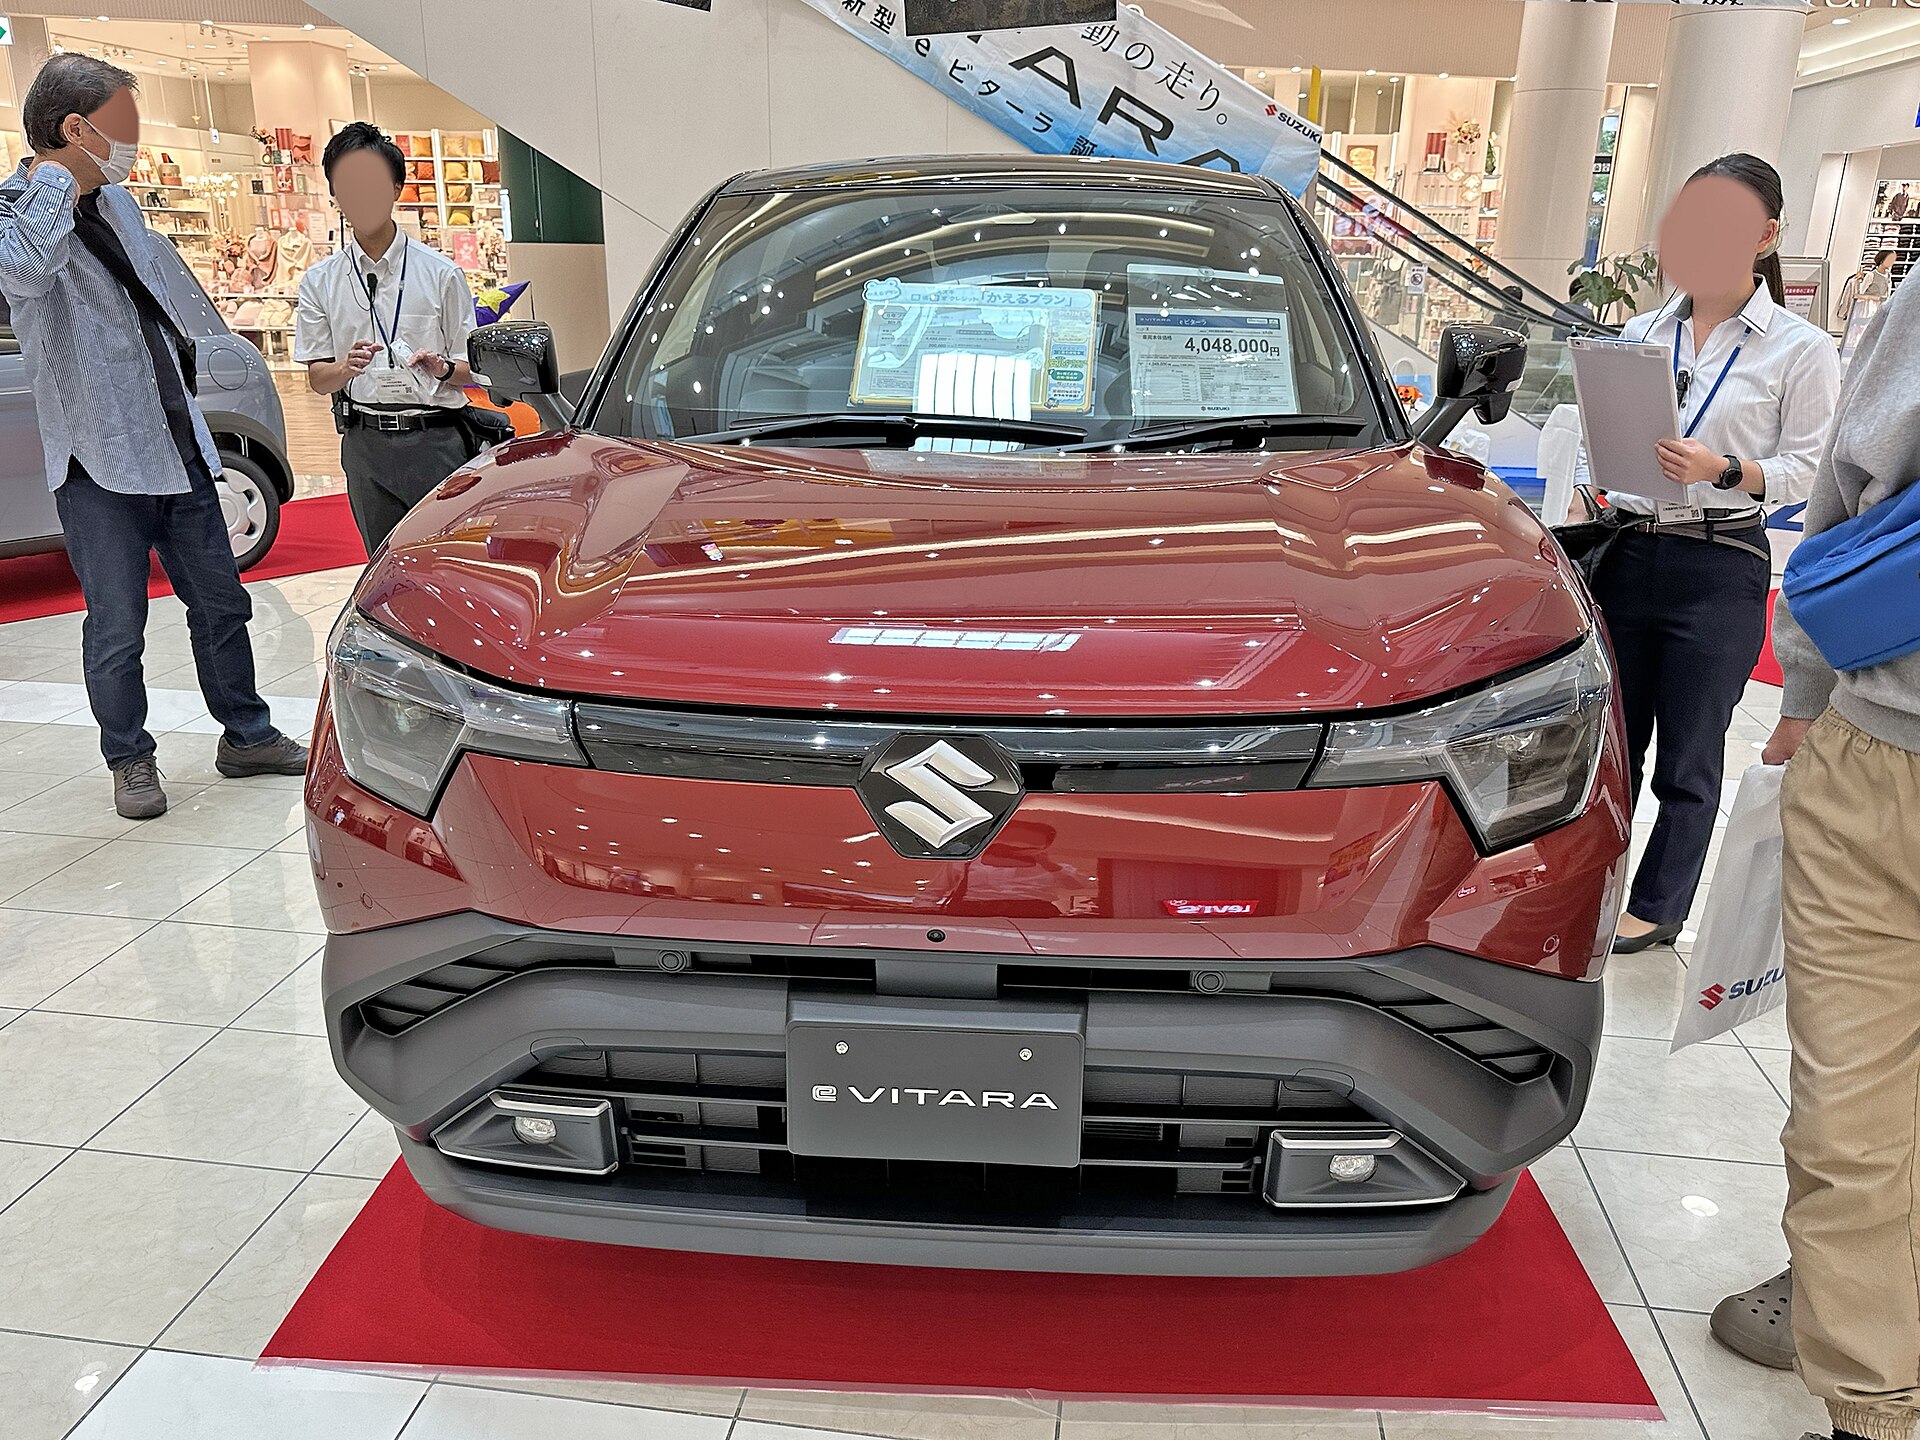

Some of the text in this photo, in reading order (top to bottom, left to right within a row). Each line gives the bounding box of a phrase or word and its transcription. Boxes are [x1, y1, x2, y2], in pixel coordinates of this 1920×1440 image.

[1278, 112, 1322, 144] SUZUKI
[1184, 337, 1280, 356] 4,048,000円
[847, 1086, 1059, 1111] VITARA
